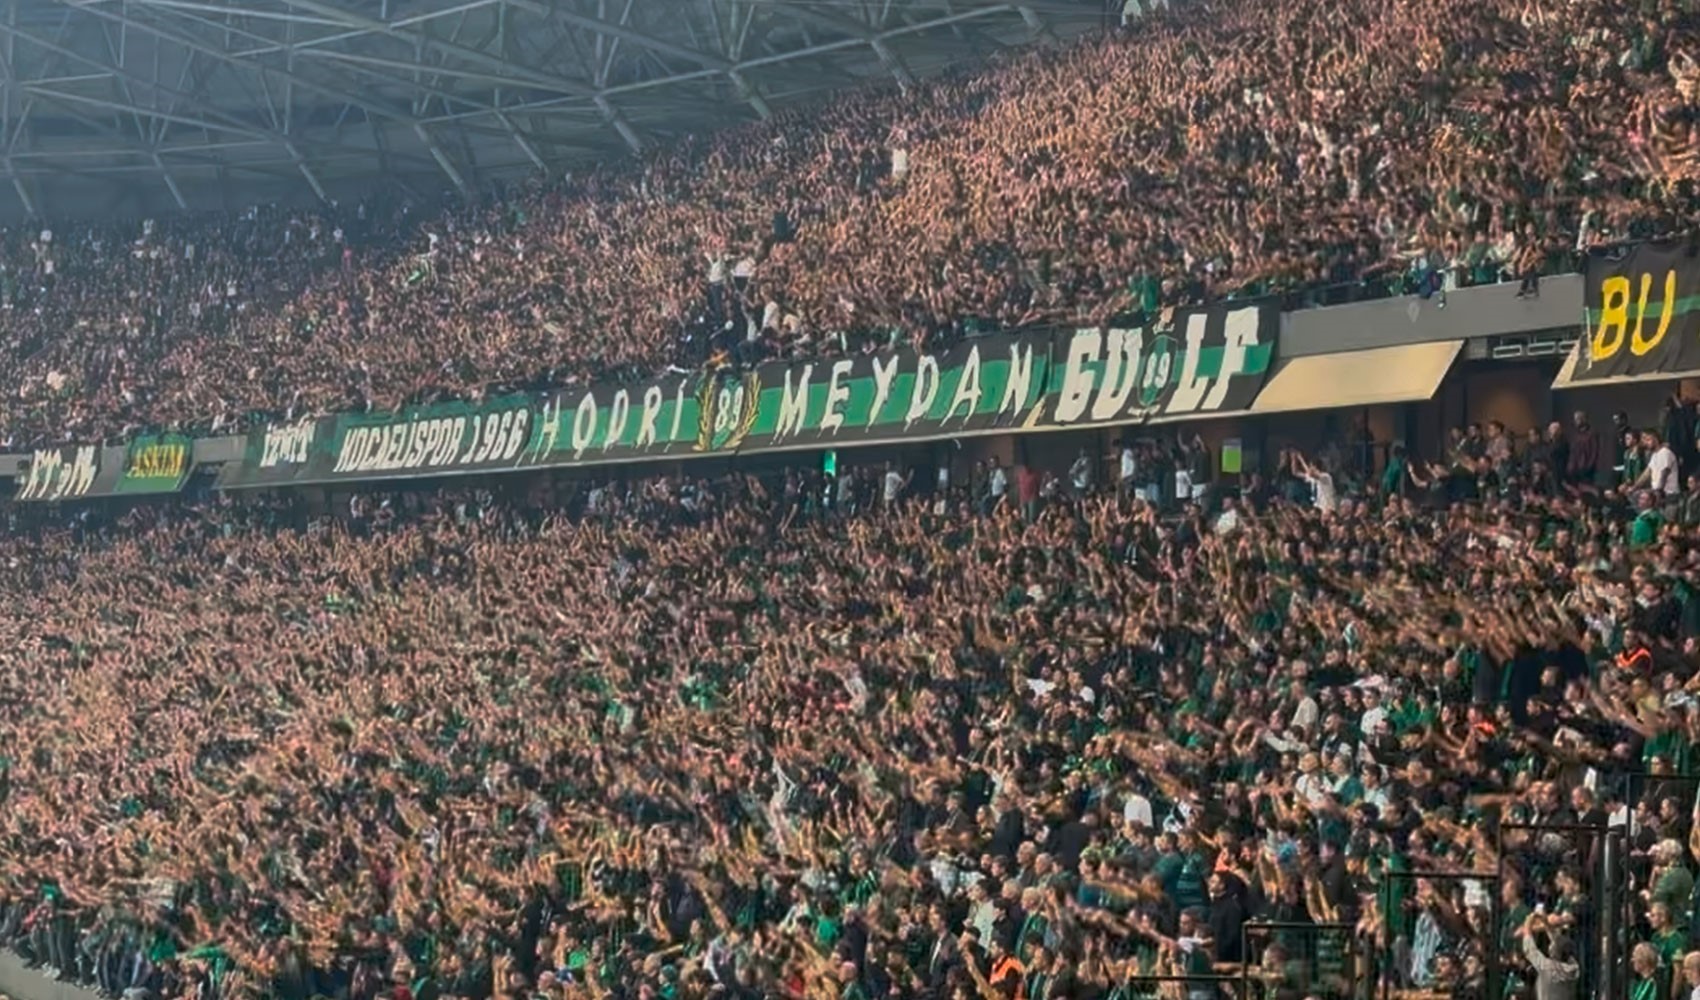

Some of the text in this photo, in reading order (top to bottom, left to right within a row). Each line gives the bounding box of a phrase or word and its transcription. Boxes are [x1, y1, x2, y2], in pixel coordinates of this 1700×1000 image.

[1591, 270, 1676, 361] BU
[714, 386, 744, 432] 89
[769, 343, 1033, 446] MEYDAN
[460, 408, 528, 464] 1966
